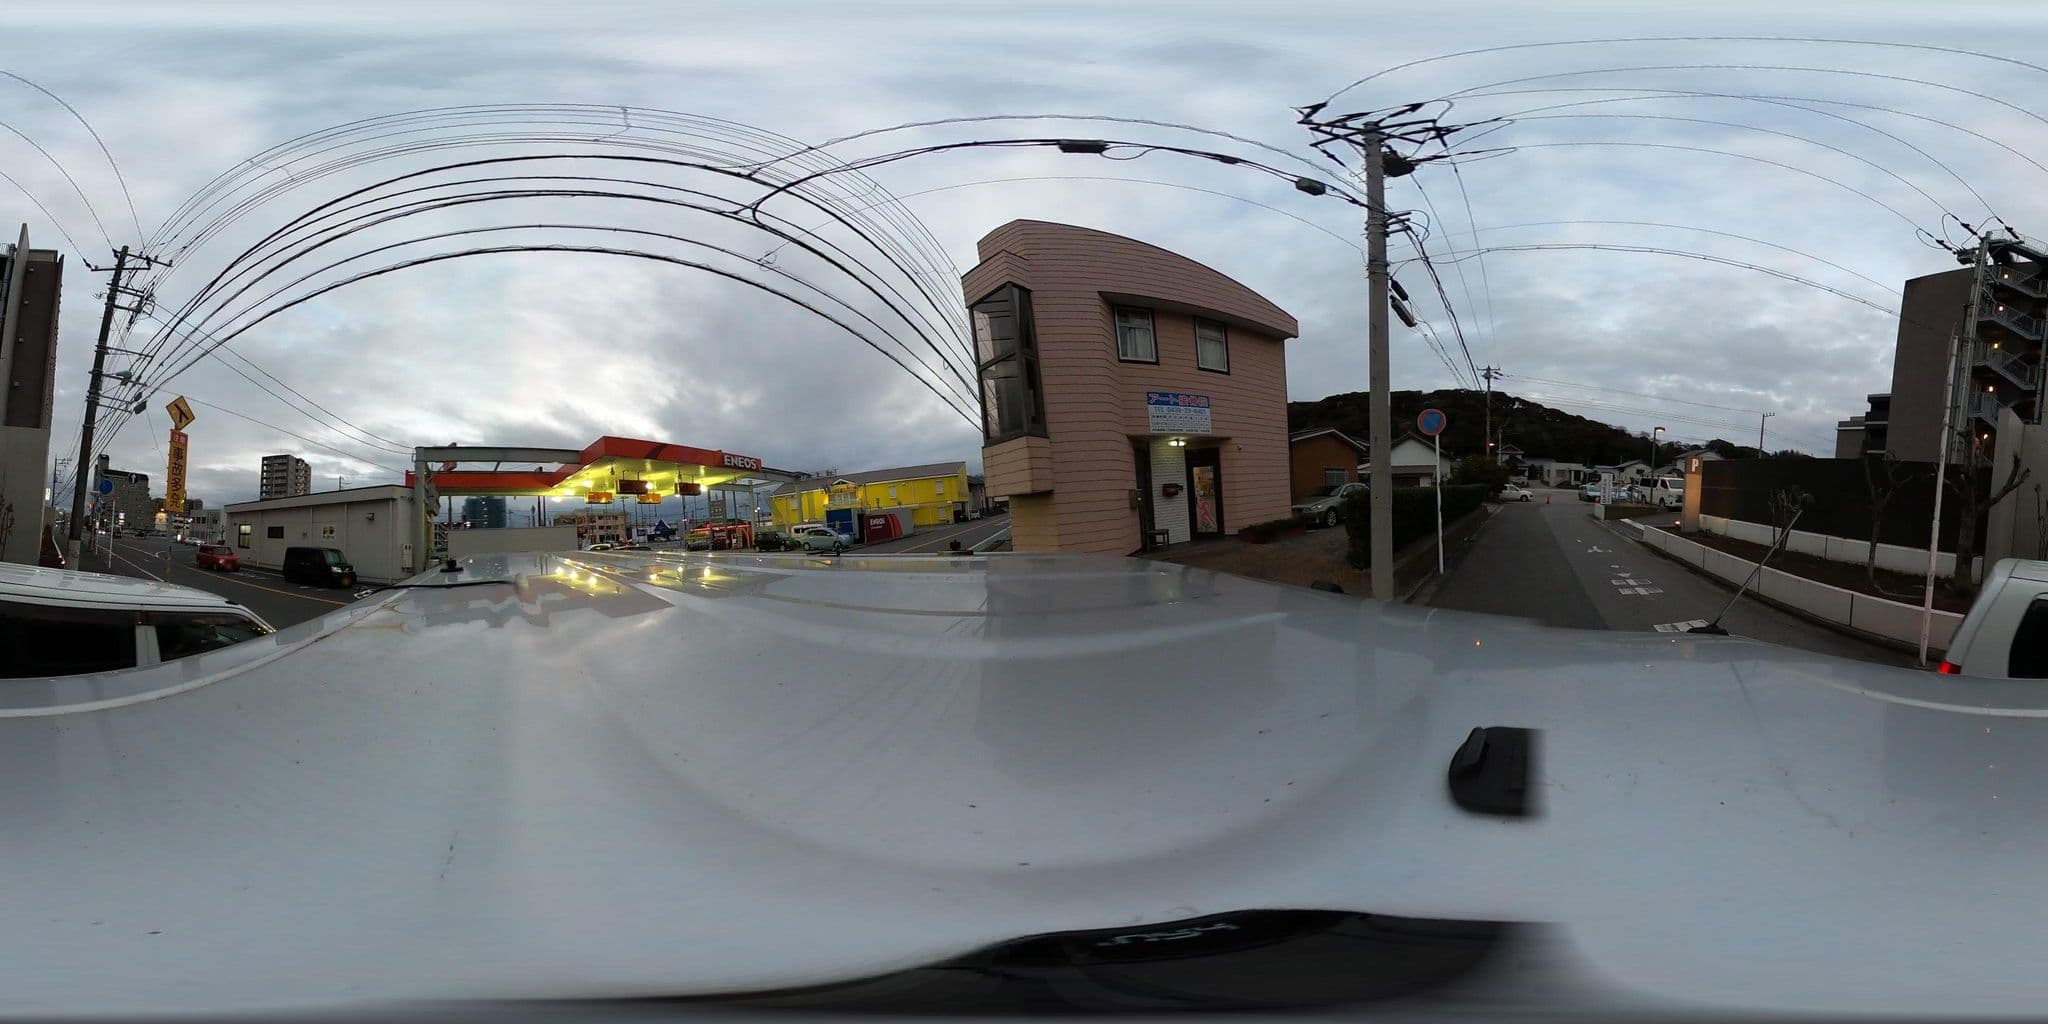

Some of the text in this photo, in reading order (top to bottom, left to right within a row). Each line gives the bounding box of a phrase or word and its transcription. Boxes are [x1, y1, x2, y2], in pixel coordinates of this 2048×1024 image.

[723, 454, 757, 470] ENEOS
[1691, 458, 1699, 473] P
[170, 446, 184, 508] 事故多発
[869, 517, 886, 526] ENEOS
